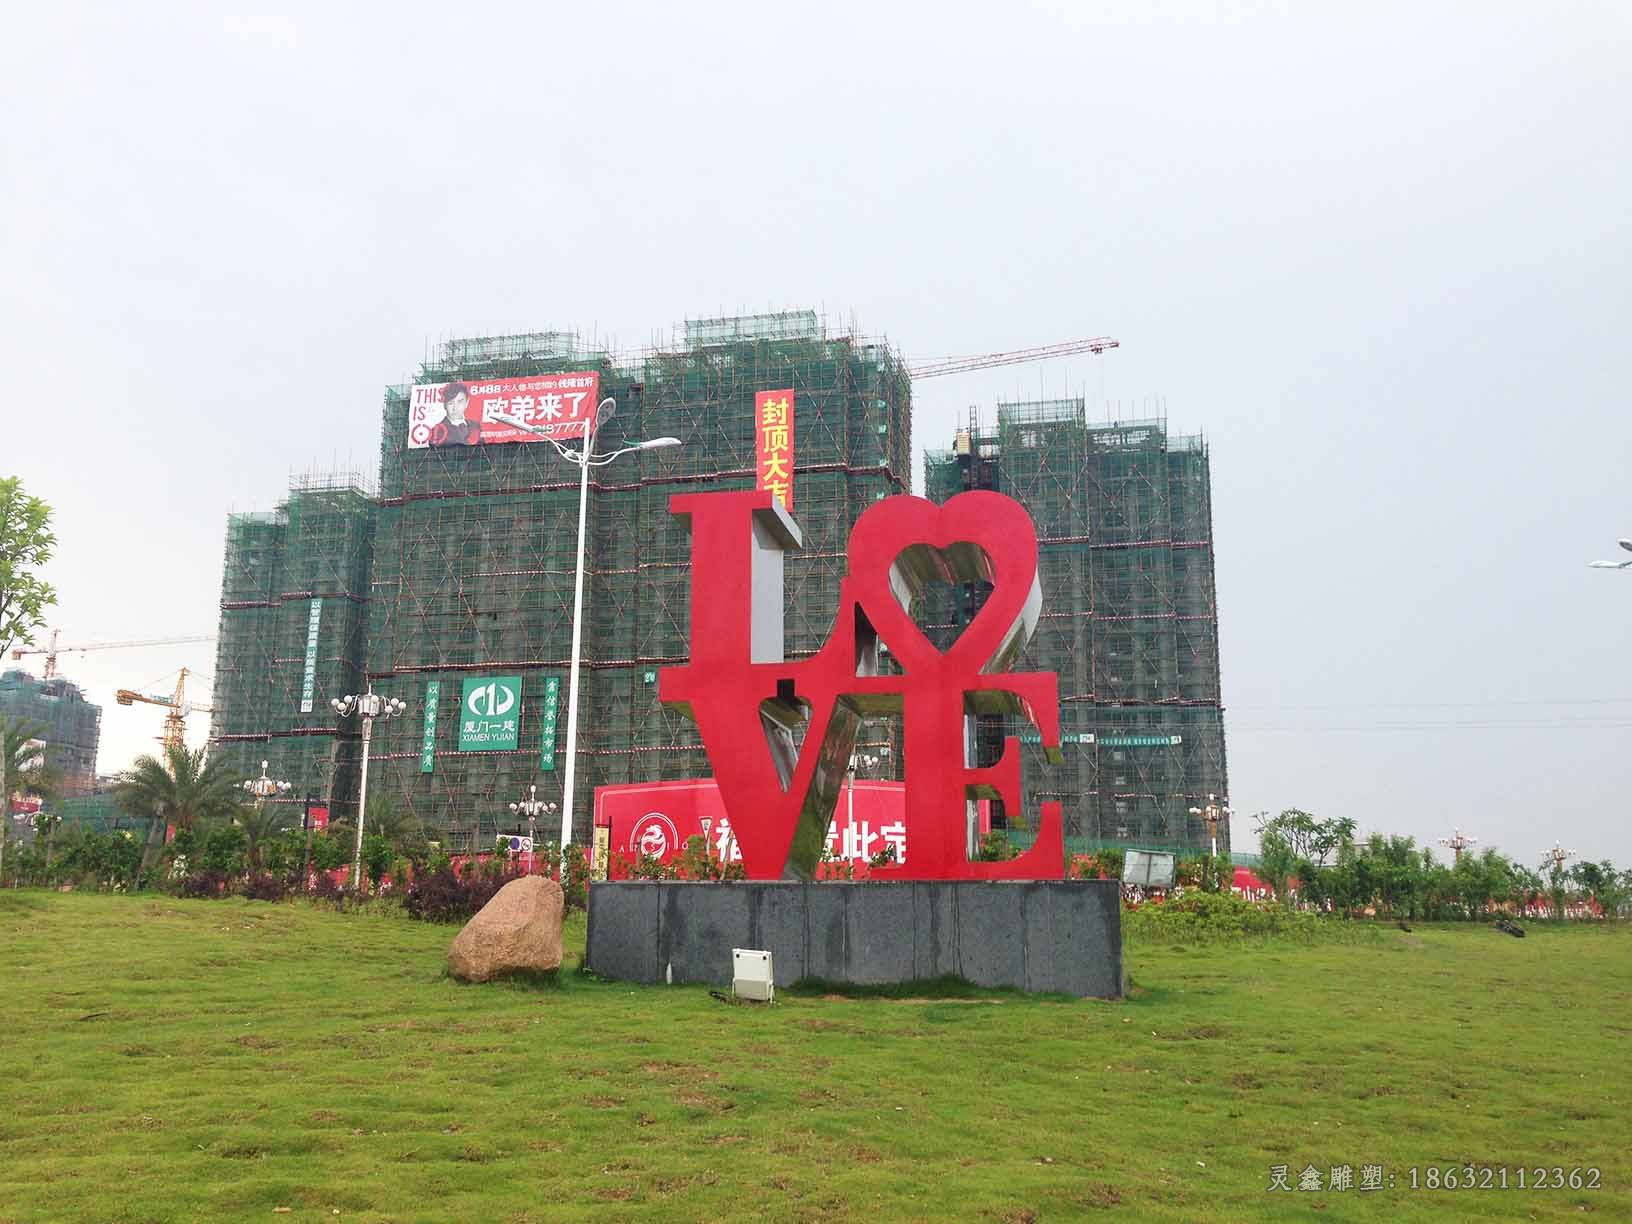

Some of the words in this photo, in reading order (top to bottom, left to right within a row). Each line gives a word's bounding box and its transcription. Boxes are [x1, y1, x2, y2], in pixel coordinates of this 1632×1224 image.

[416, 387, 446, 404] THIS
[413, 405, 426, 421] IS
[482, 392, 588, 424] 欧弟来了
[463, 719, 516, 733] 厦门一建
[462, 733, 490, 742] XIAMEN
